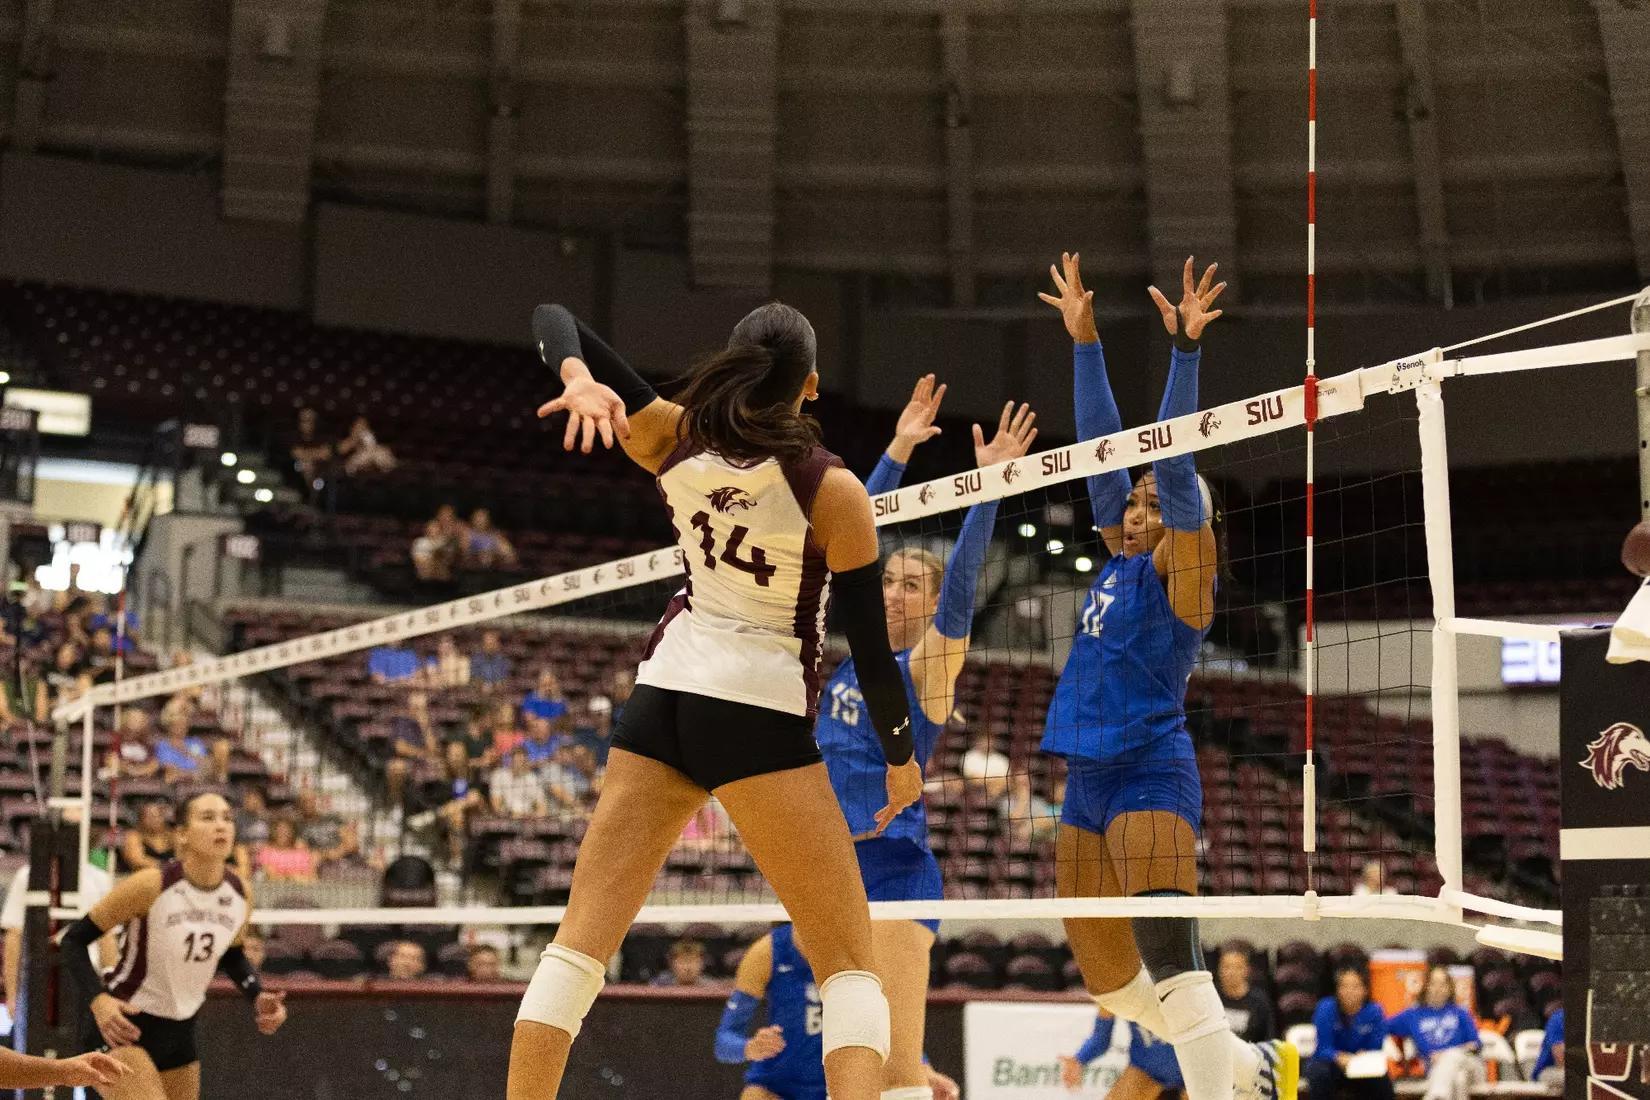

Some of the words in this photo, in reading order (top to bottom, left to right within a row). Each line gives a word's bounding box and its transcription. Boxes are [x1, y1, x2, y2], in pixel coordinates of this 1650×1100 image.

[1402, 359, 1424, 371] Senoh
[874, 493, 900, 517] SIU
[954, 471, 983, 497] SIU
[1041, 450, 1072, 476] SIU
[1137, 424, 1173, 453] SIU
[1245, 394, 1284, 426] SIU
[690, 510, 777, 588] 14
[562, 574, 582, 592] SIU
[615, 559, 635, 580] SIU
[831, 682, 864, 727] 15
[183, 932, 215, 962] 13
[992, 1056, 1119, 1088] Bantrra
